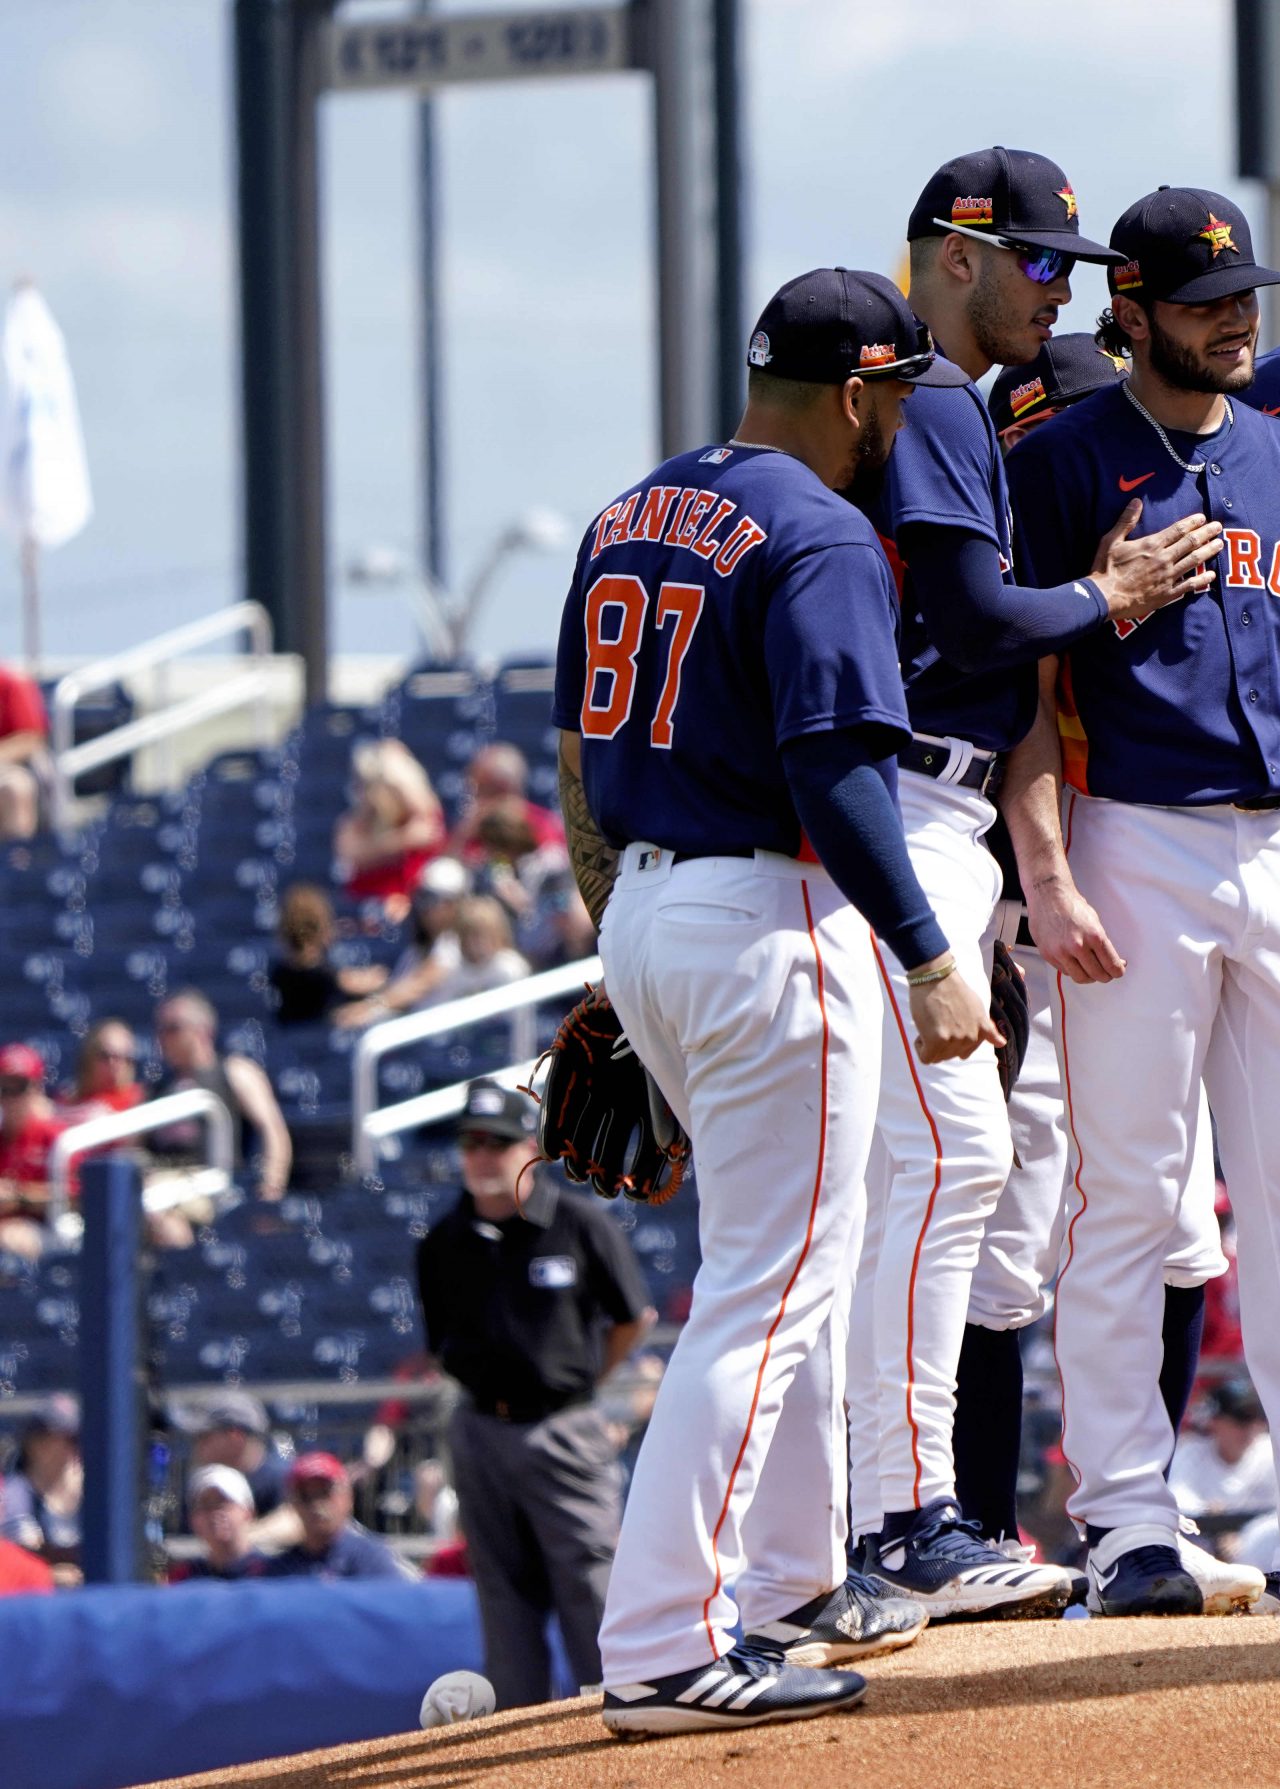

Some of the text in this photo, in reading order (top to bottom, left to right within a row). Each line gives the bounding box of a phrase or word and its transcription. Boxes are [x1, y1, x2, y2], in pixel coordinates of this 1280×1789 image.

[952, 196, 993, 209] Astros
[1010, 377, 1042, 402] Astros
[590, 486, 768, 578] TANIELU
[580, 573, 706, 750] 87
